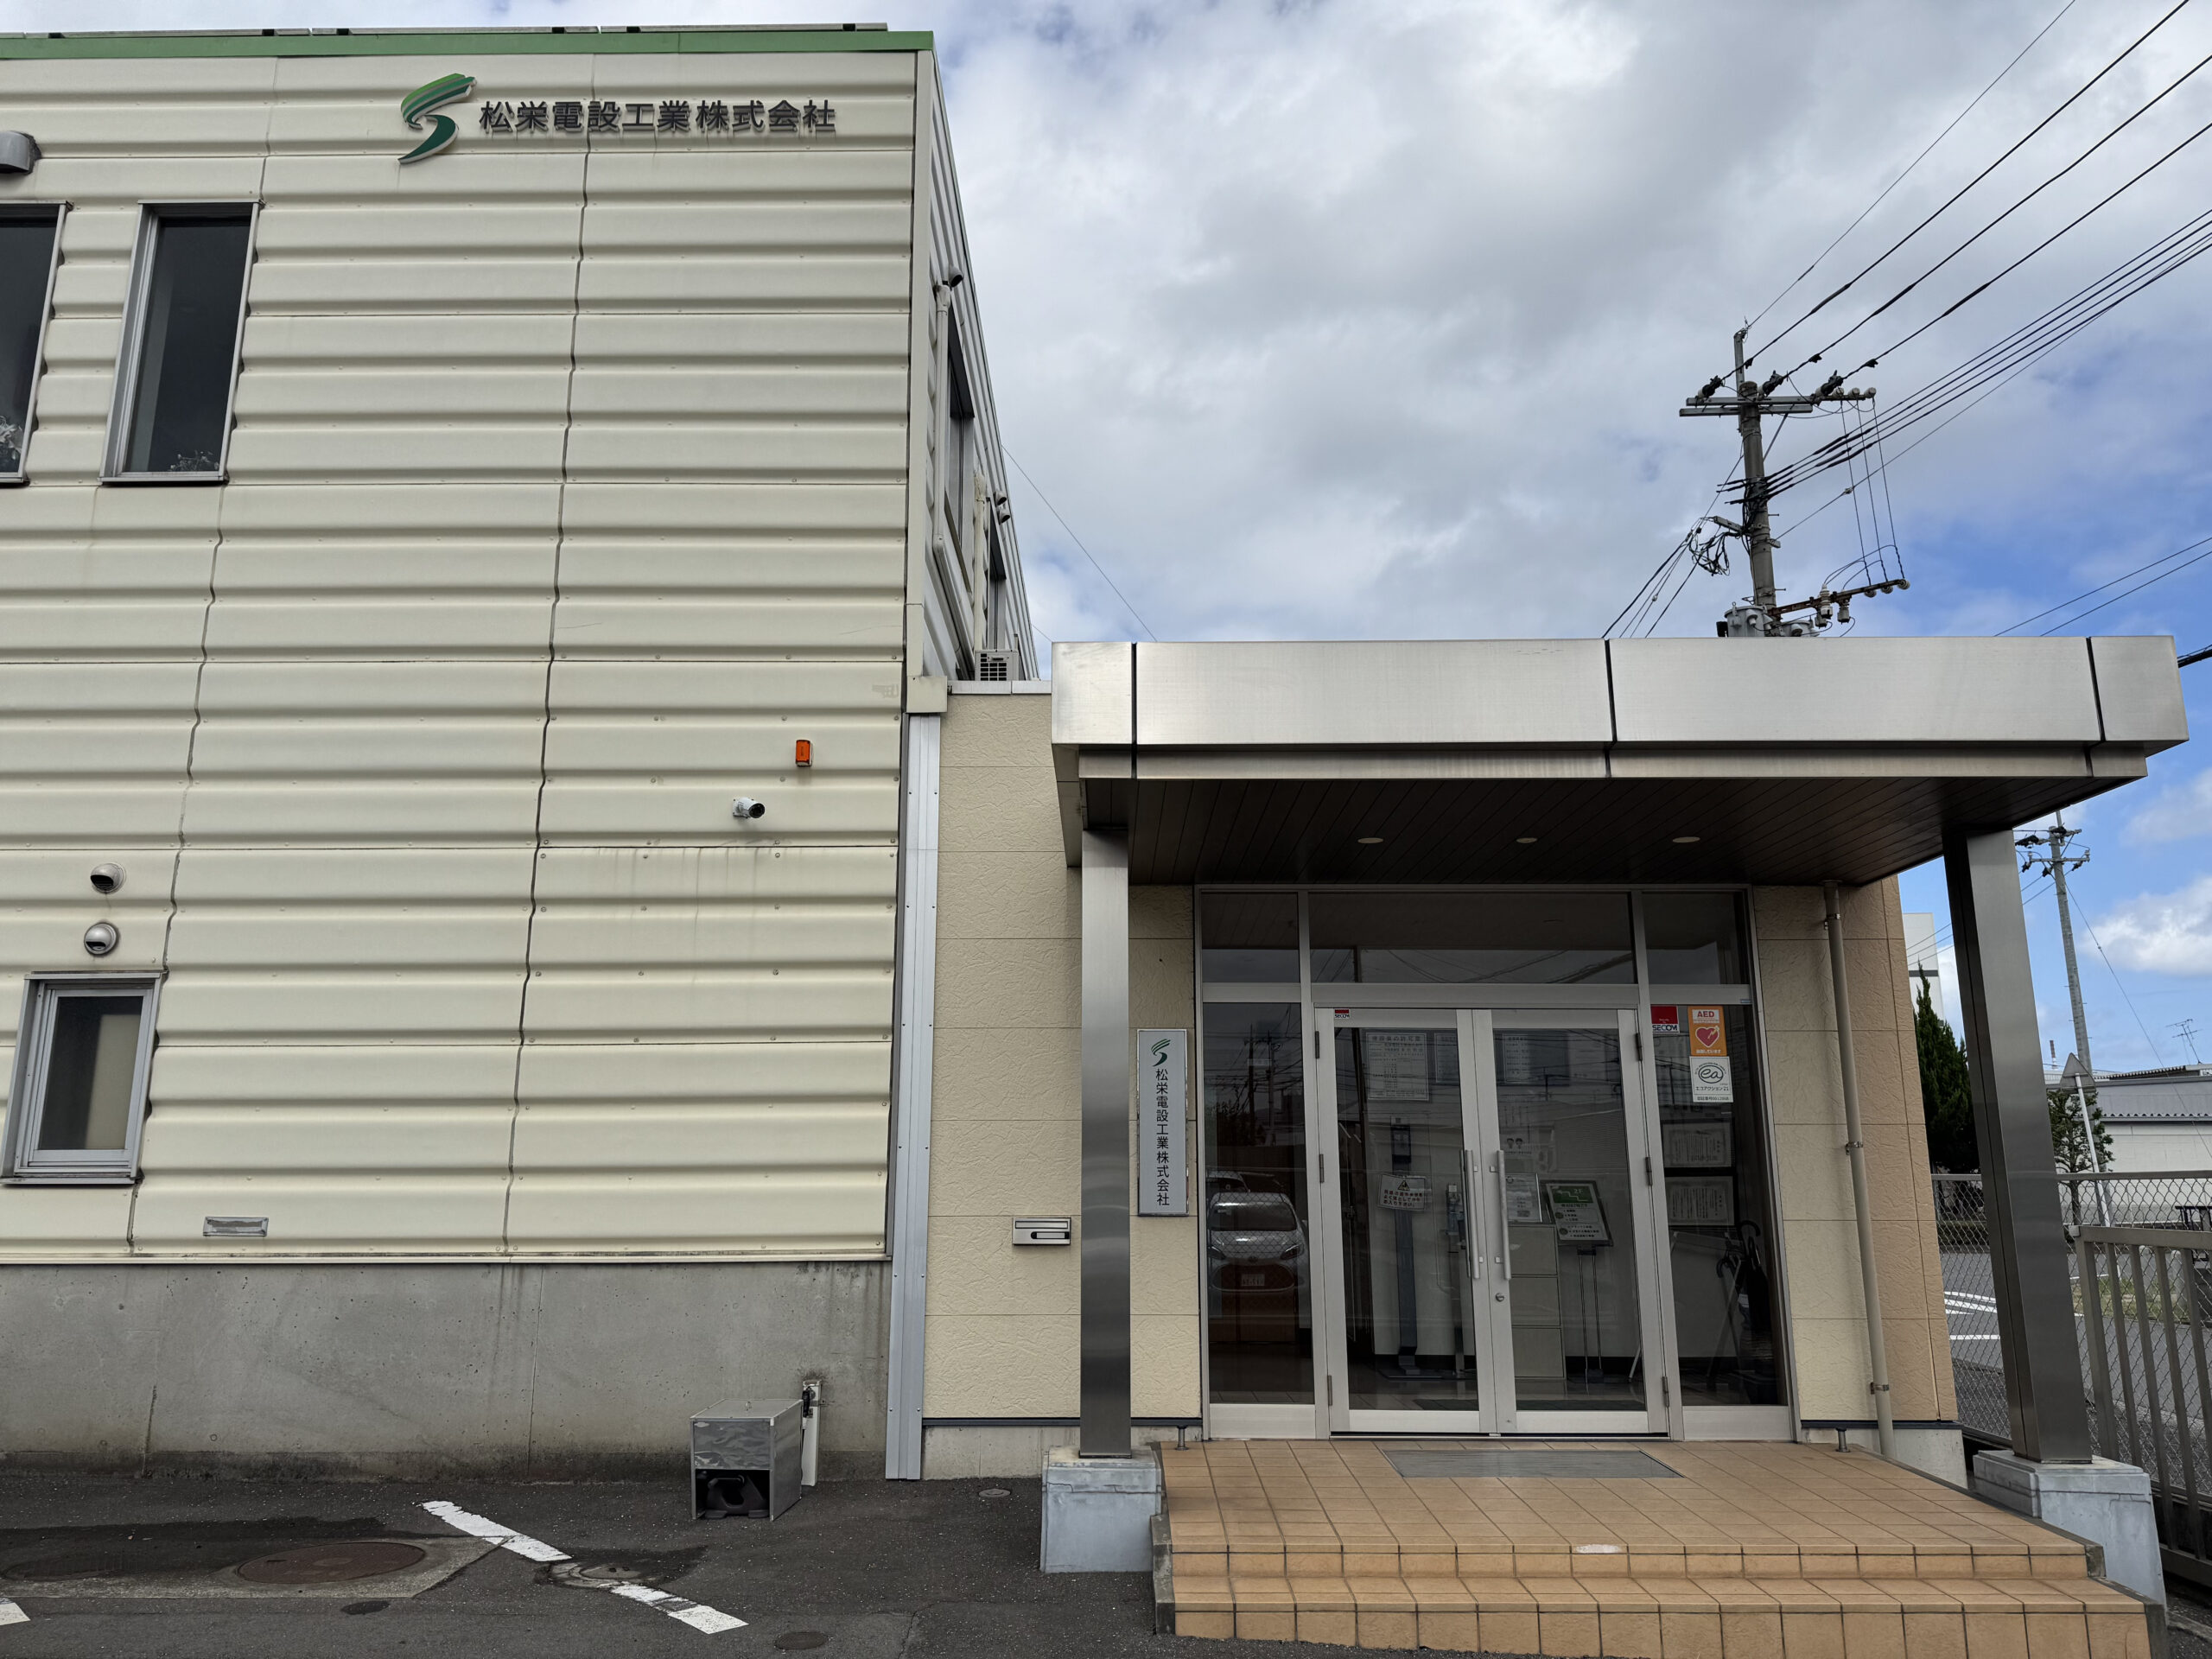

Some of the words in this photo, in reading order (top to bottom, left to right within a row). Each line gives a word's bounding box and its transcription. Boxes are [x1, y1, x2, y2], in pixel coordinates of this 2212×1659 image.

[480, 100, 835, 133] 松栄電設工業株式会社
[1155, 1068, 1170, 1206] 松栄電設工業株式会社
